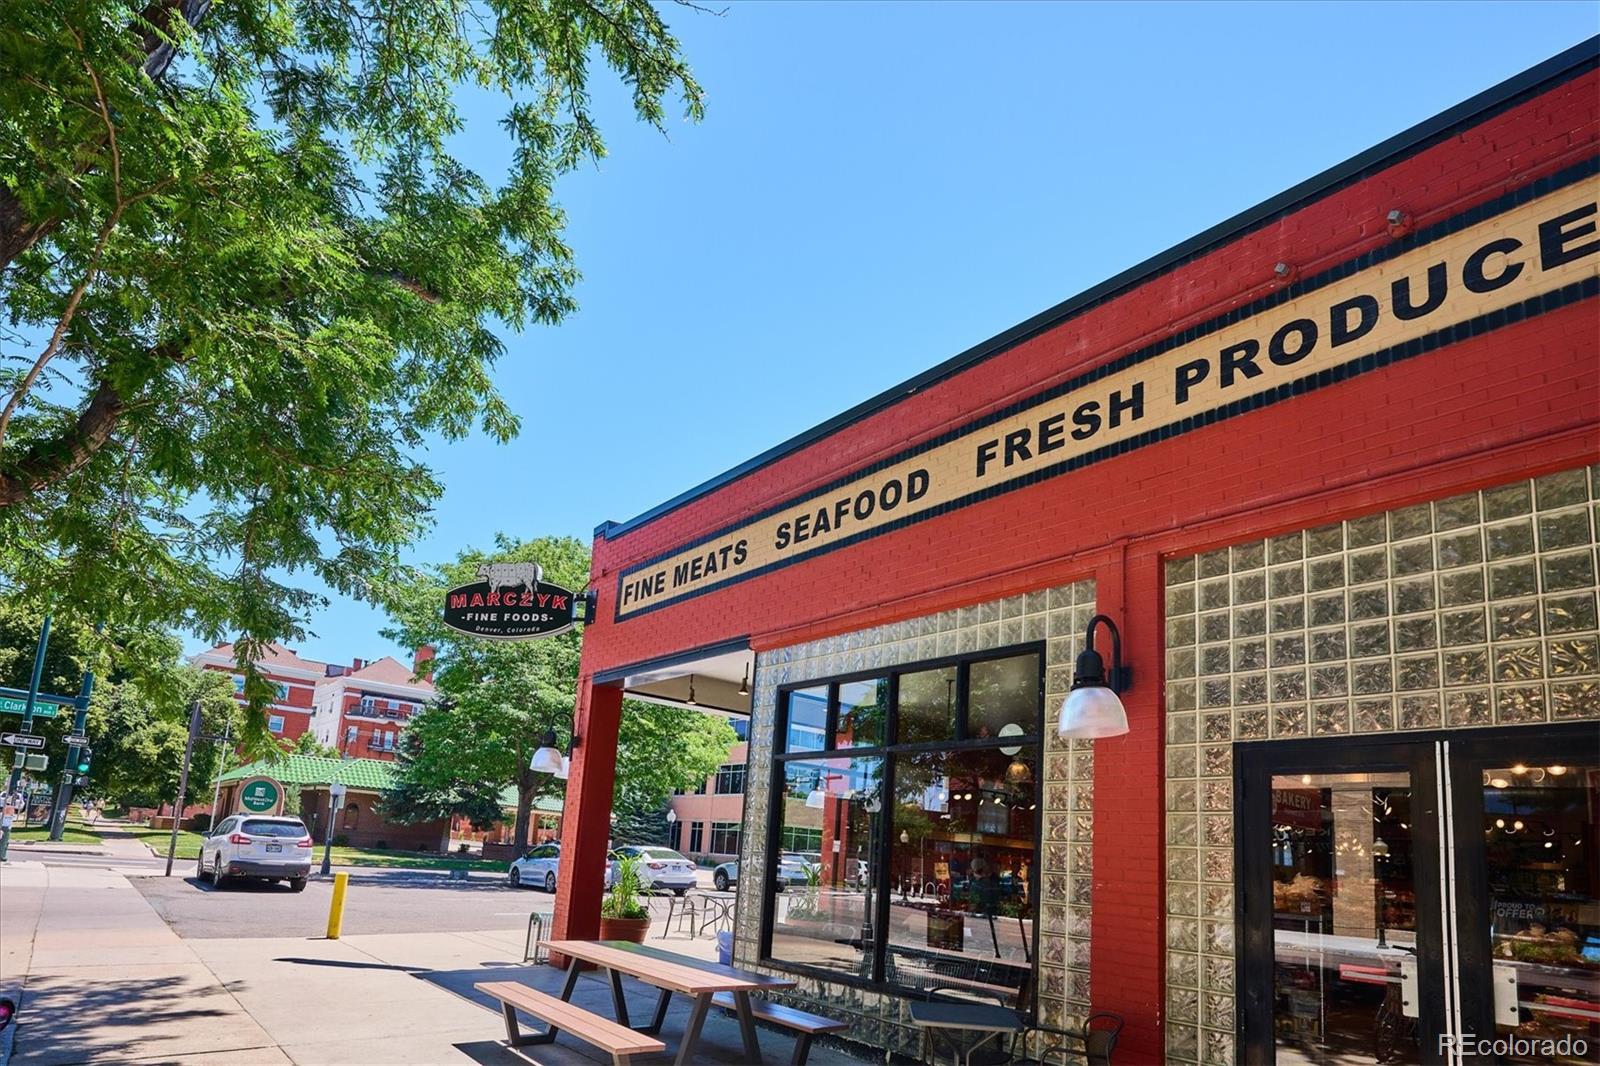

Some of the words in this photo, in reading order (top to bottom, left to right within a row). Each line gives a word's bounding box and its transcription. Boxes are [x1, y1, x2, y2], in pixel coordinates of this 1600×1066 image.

[623, 571, 666, 606] FINE
[673, 539, 748, 589] MEATS
[775, 468, 930, 550] SEAFOOD
[976, 382, 1145, 477] FRESH
[1175, 202, 1600, 403] PRODUCE
[450, 592, 567, 610] MARCZYK
[506, 625, 540, 633] Colorado
[1276, 790, 1311, 810] BAKERY
[1497, 902, 1522, 910] PROUD
[1496, 908, 1534, 920] OFFER
